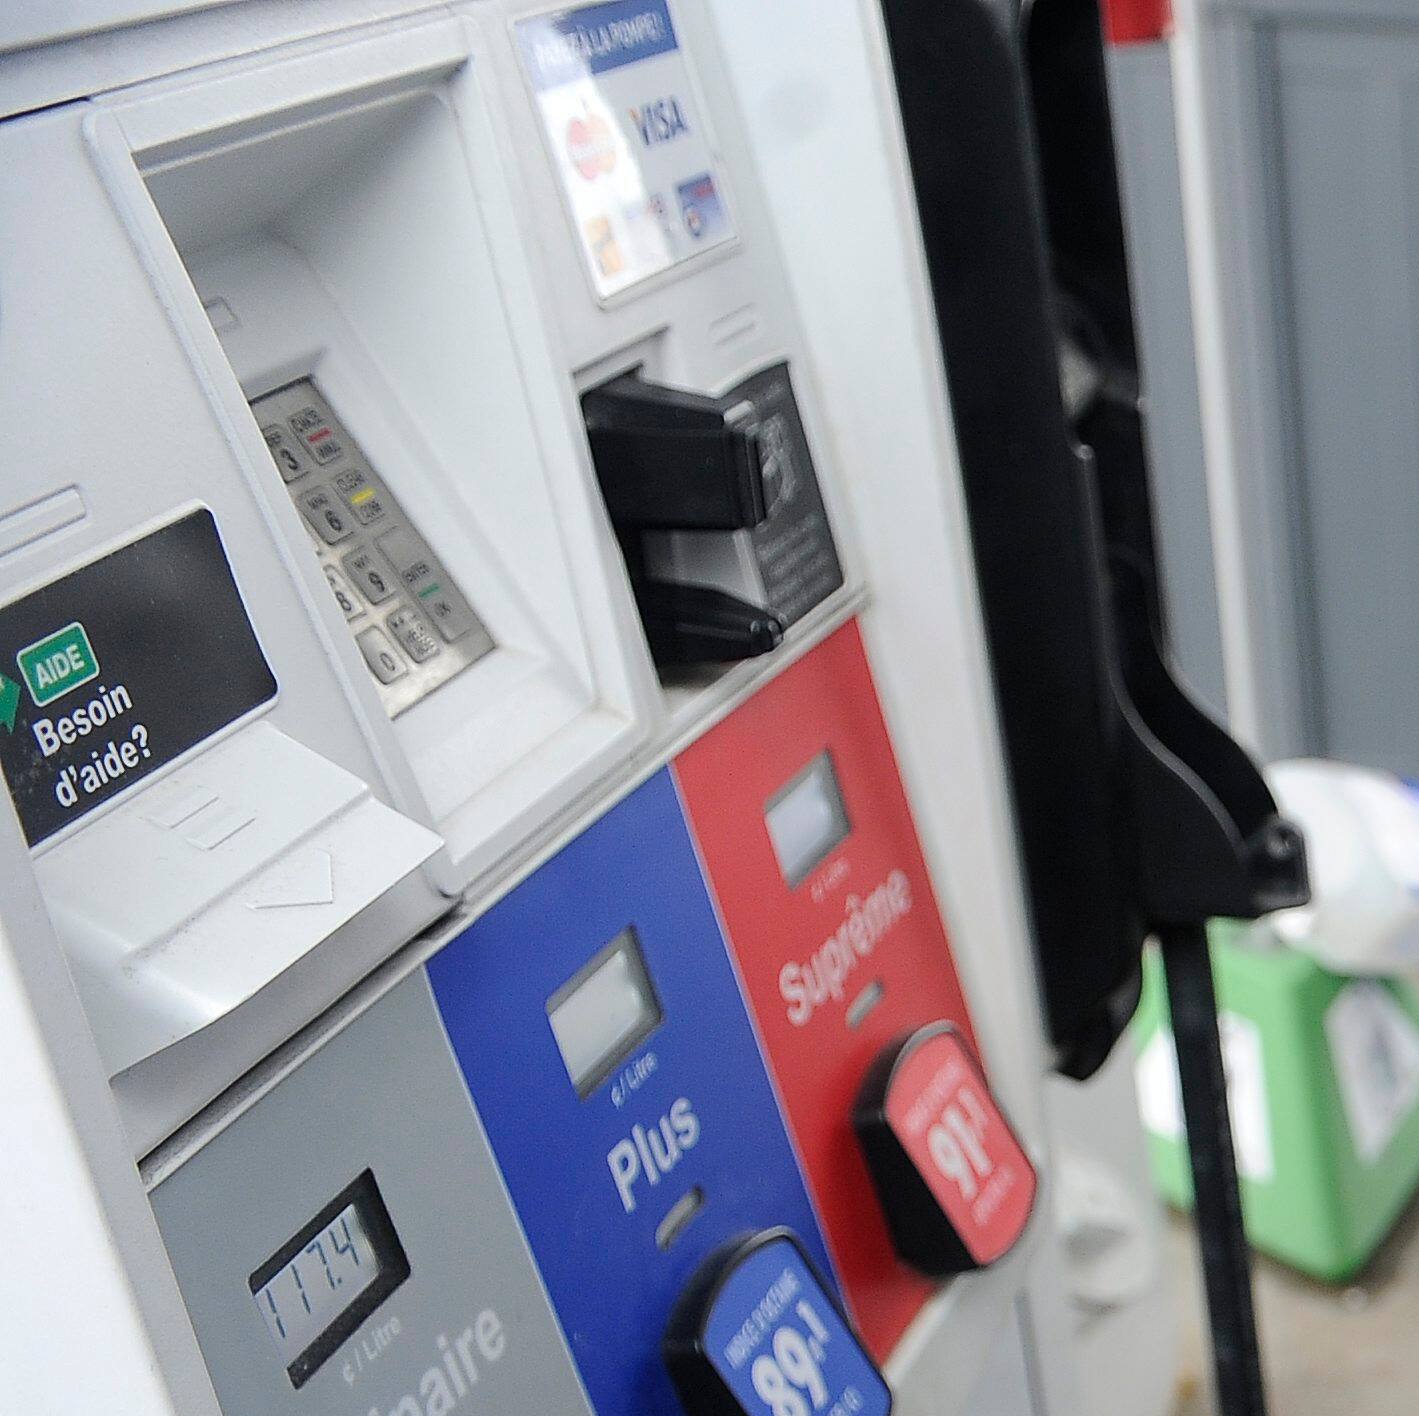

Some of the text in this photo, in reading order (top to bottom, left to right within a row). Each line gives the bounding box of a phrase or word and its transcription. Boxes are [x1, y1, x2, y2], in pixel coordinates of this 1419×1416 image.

[627, 94, 689, 146] VISA
[35, 644, 85, 689] AIDE
[32, 685, 133, 757] Besoin
[55, 724, 151, 807] d'aide?
[607, 1097, 700, 1214] Plus
[265, 1216, 359, 1339] 117.4
